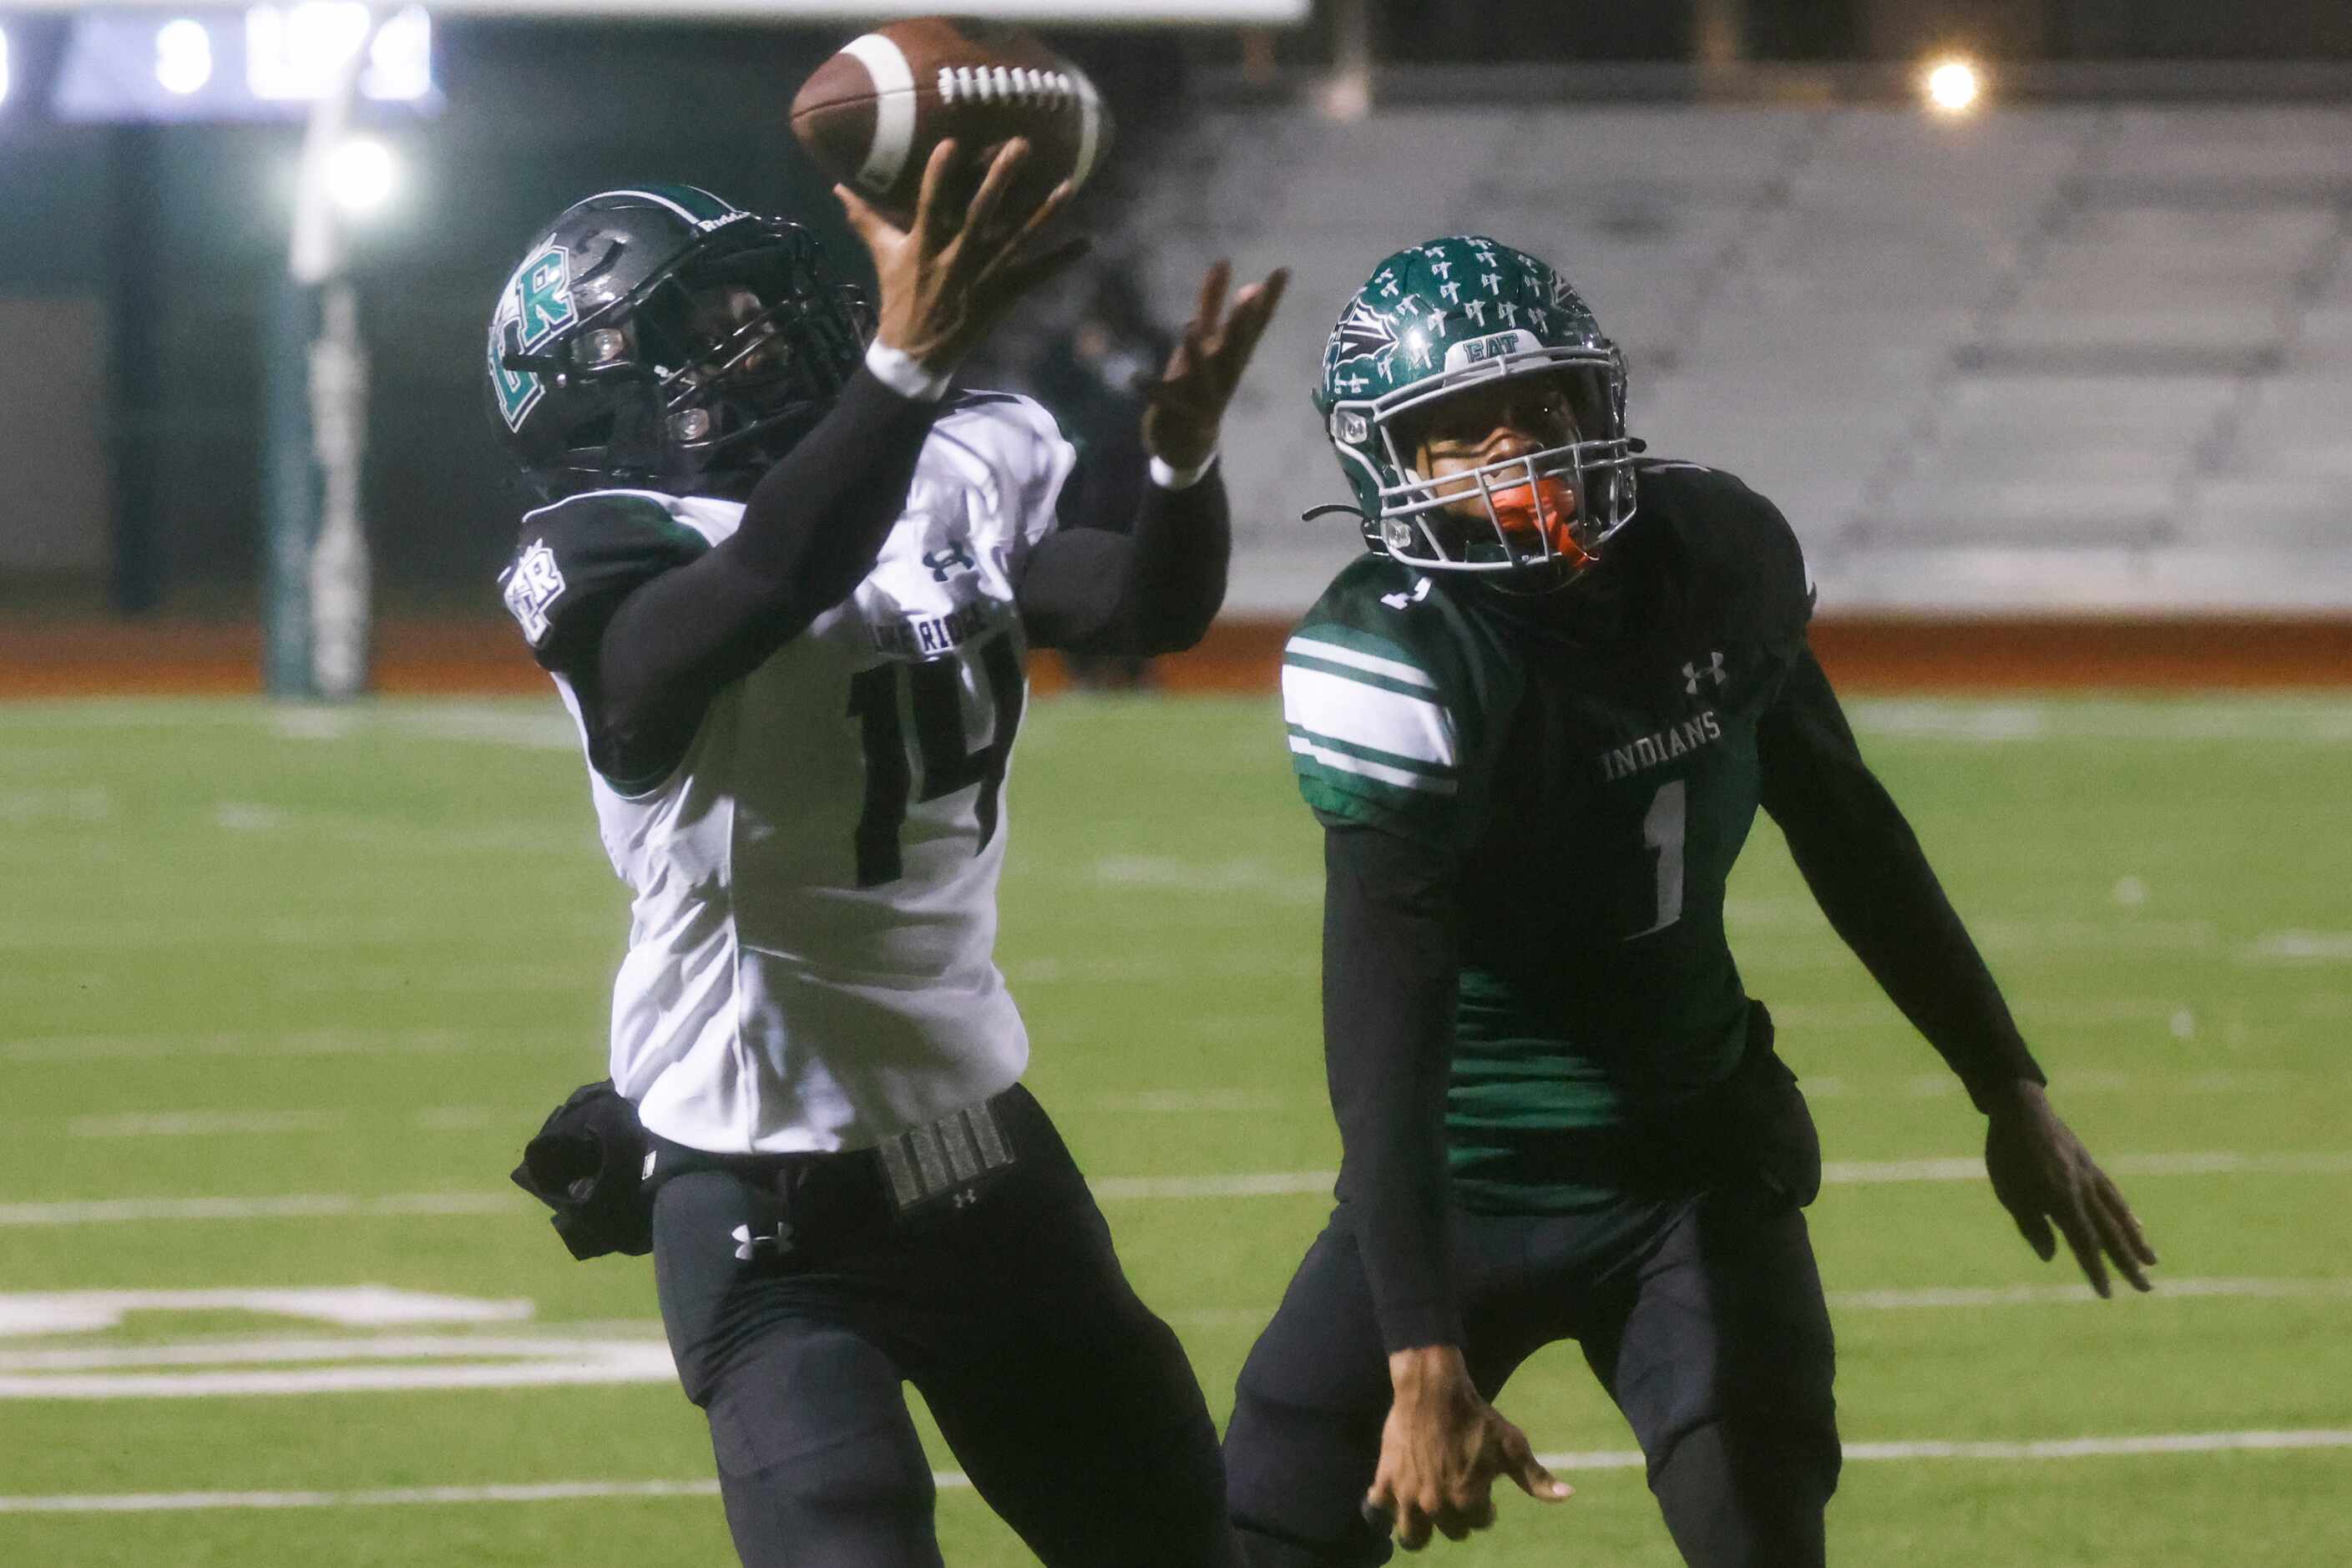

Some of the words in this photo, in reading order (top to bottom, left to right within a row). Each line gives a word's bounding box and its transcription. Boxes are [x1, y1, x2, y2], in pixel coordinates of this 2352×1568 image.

[697, 212, 750, 232] Ridd
[1463, 332, 1519, 363] EAT
[847, 629, 1024, 887] 14
[1602, 711, 1721, 783] INDIANS
[1623, 778, 1686, 942] 1
